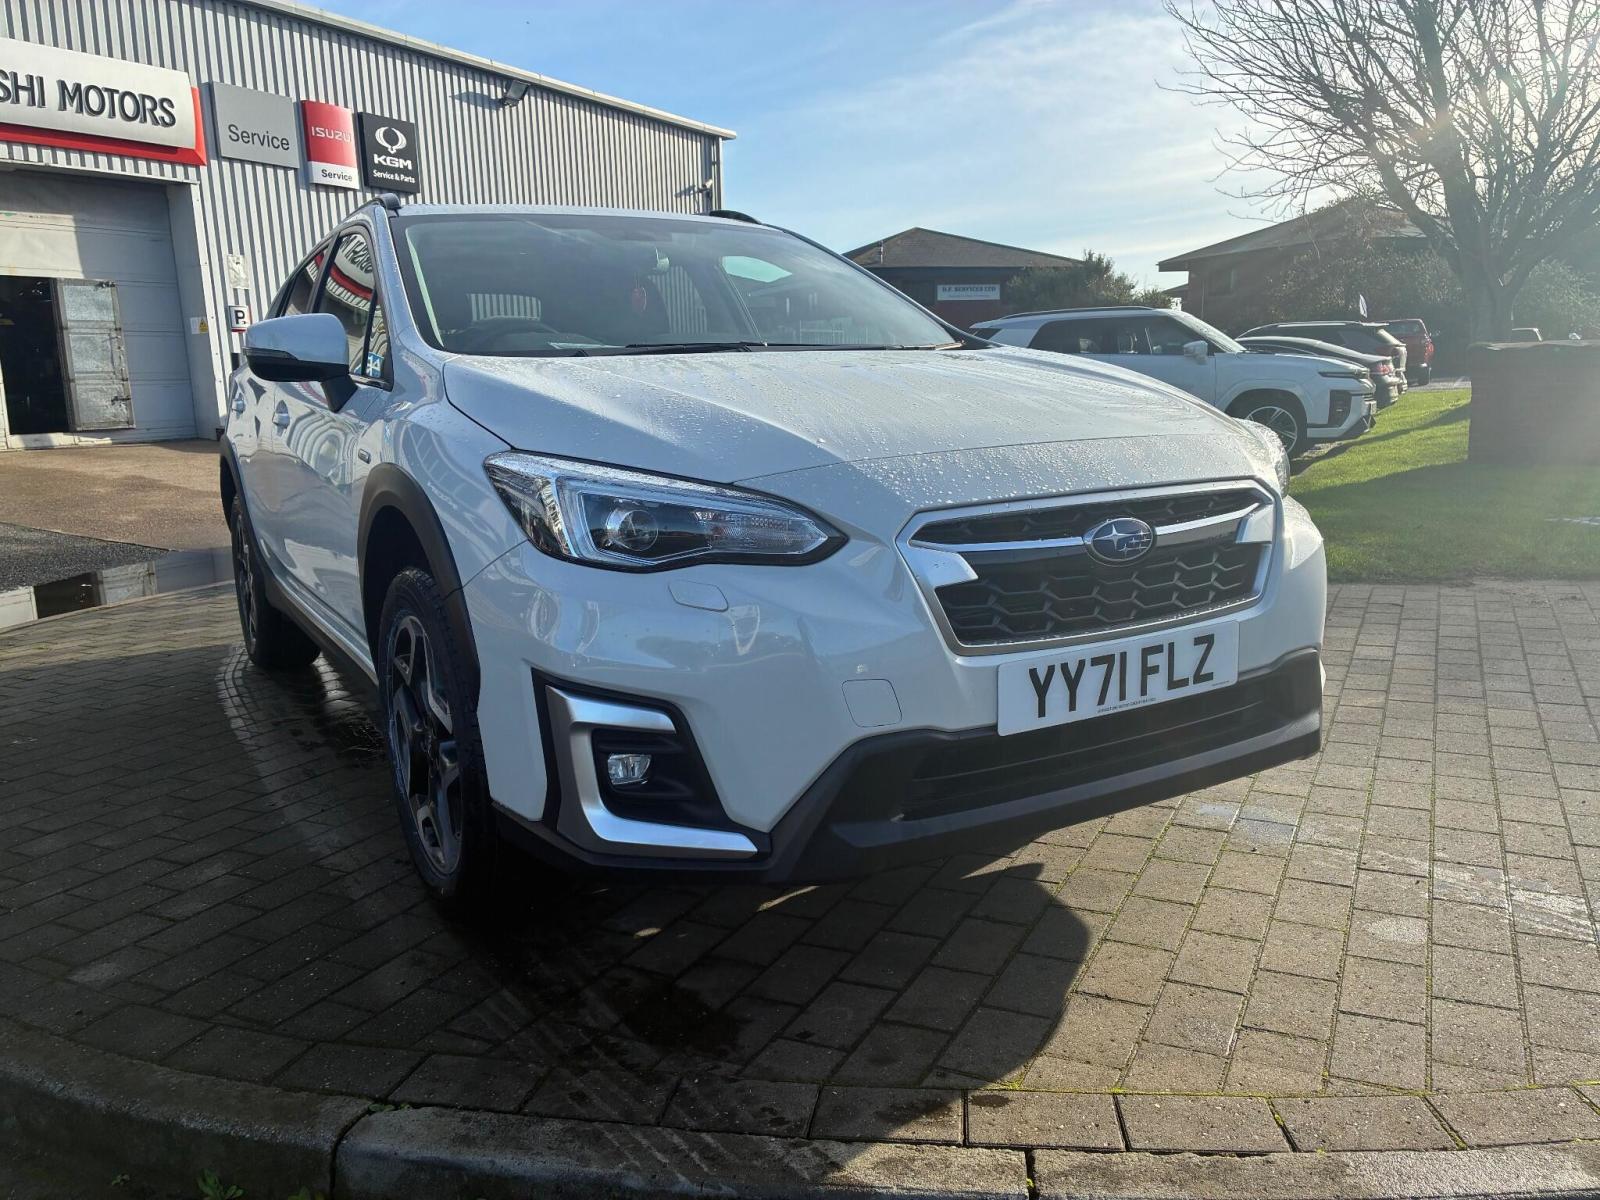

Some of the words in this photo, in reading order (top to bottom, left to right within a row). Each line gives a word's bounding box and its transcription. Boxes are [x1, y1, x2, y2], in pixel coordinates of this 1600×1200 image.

[56, 79, 177, 128] MOTORS
[228, 124, 290, 151] Service
[311, 126, 352, 143] ISUZU
[373, 153, 412, 170] KGM
[321, 169, 353, 182] Service
[373, 169, 394, 180] Service
[400, 174, 416, 184] Parts
[1028, 651, 1127, 719] YY71
[1140, 633, 1215, 697] FLZ
